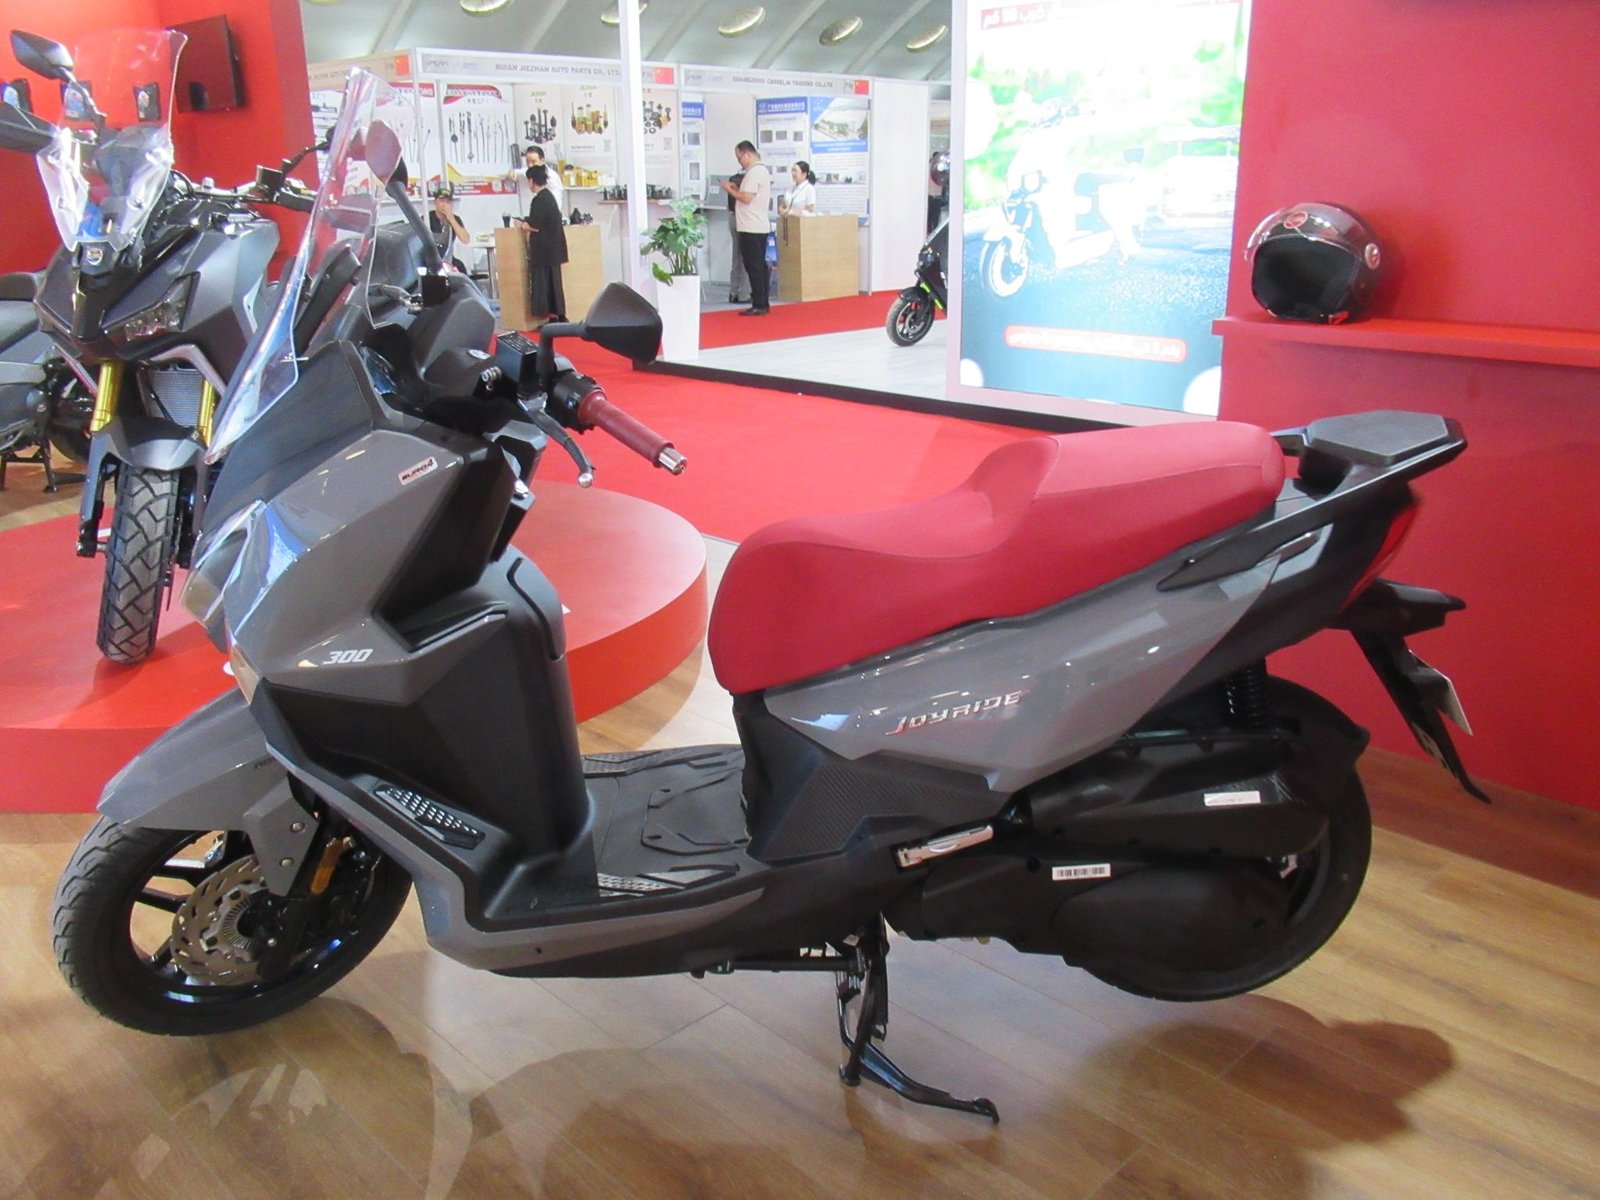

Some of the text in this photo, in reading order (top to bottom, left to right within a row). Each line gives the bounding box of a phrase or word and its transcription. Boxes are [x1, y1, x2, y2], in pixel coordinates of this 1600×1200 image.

[551, 66, 570, 74] AUTO
[571, 67, 592, 75] PARTS
[322, 648, 374, 665] 300
[885, 689, 1022, 736] JOYRIDE
